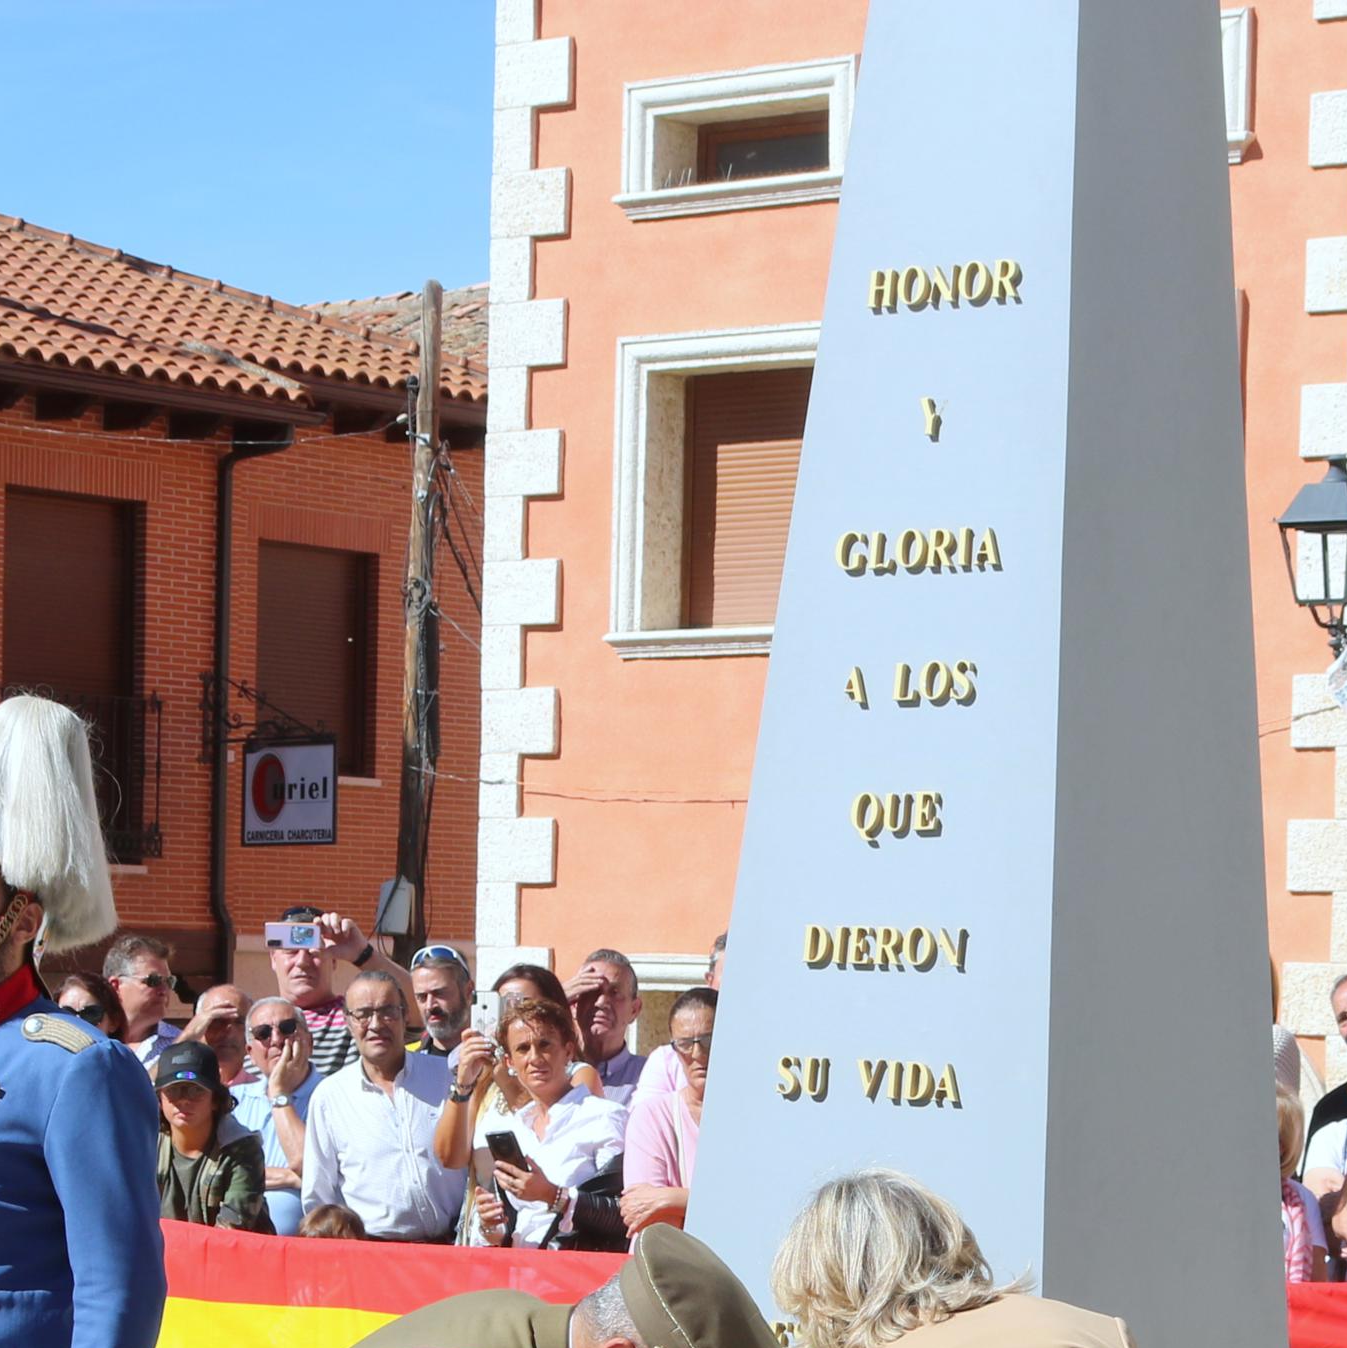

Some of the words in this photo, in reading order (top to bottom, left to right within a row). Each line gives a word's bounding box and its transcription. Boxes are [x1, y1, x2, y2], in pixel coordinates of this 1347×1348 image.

[866, 258, 1023, 314] HONOR
[919, 396, 949, 443] Y
[834, 526, 1003, 577] GLORIA
[843, 665, 870, 710] A
[892, 659, 978, 707] LOS
[850, 789, 944, 848] QUE
[802, 924, 970, 973] DIERON
[775, 1055, 832, 1103] SU
[858, 1058, 963, 1109] VIDA
